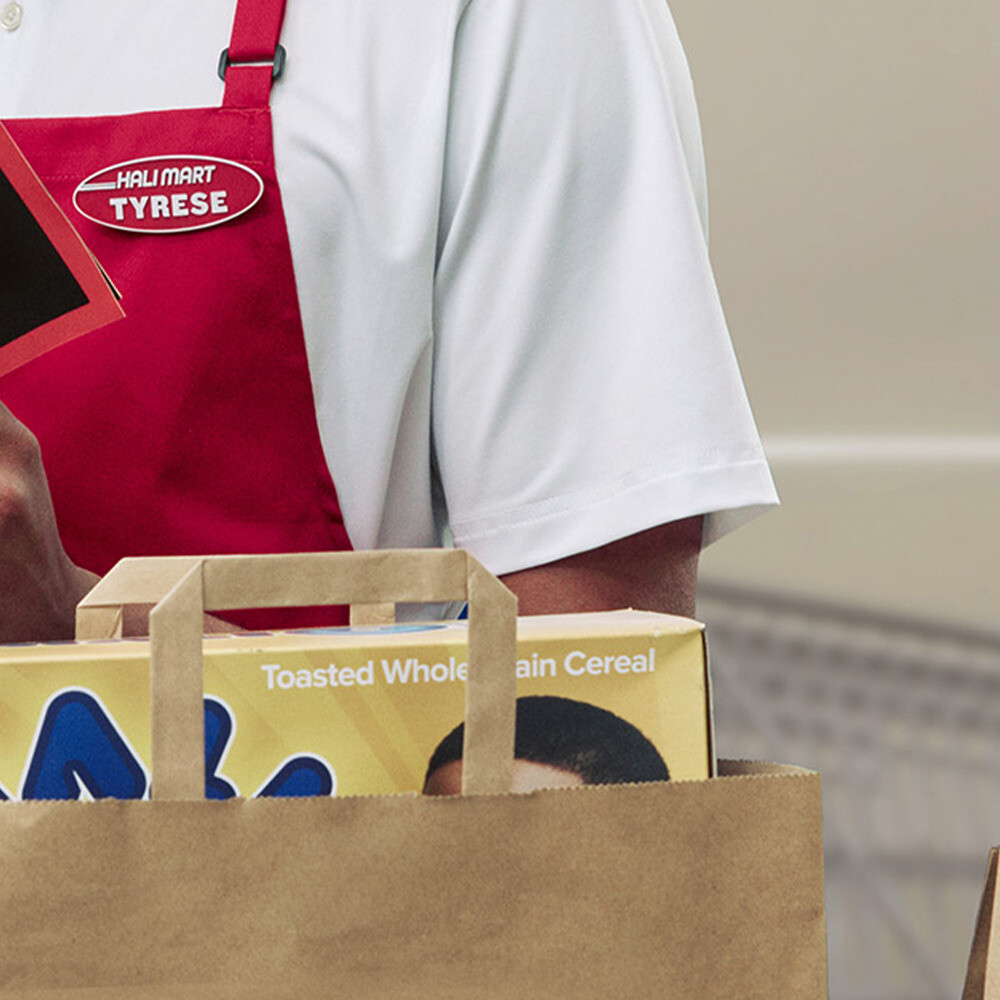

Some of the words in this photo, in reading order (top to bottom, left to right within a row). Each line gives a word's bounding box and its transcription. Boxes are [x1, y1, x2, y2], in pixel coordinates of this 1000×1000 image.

[116, 169, 158, 189] HALI
[160, 164, 217, 187] MART
[109, 190, 229, 221] TYRESE
[260, 660, 375, 690] Toasted
[381, 656, 468, 685] Whole
[515, 652, 557, 679] ain
[563, 648, 656, 676] Cereal
